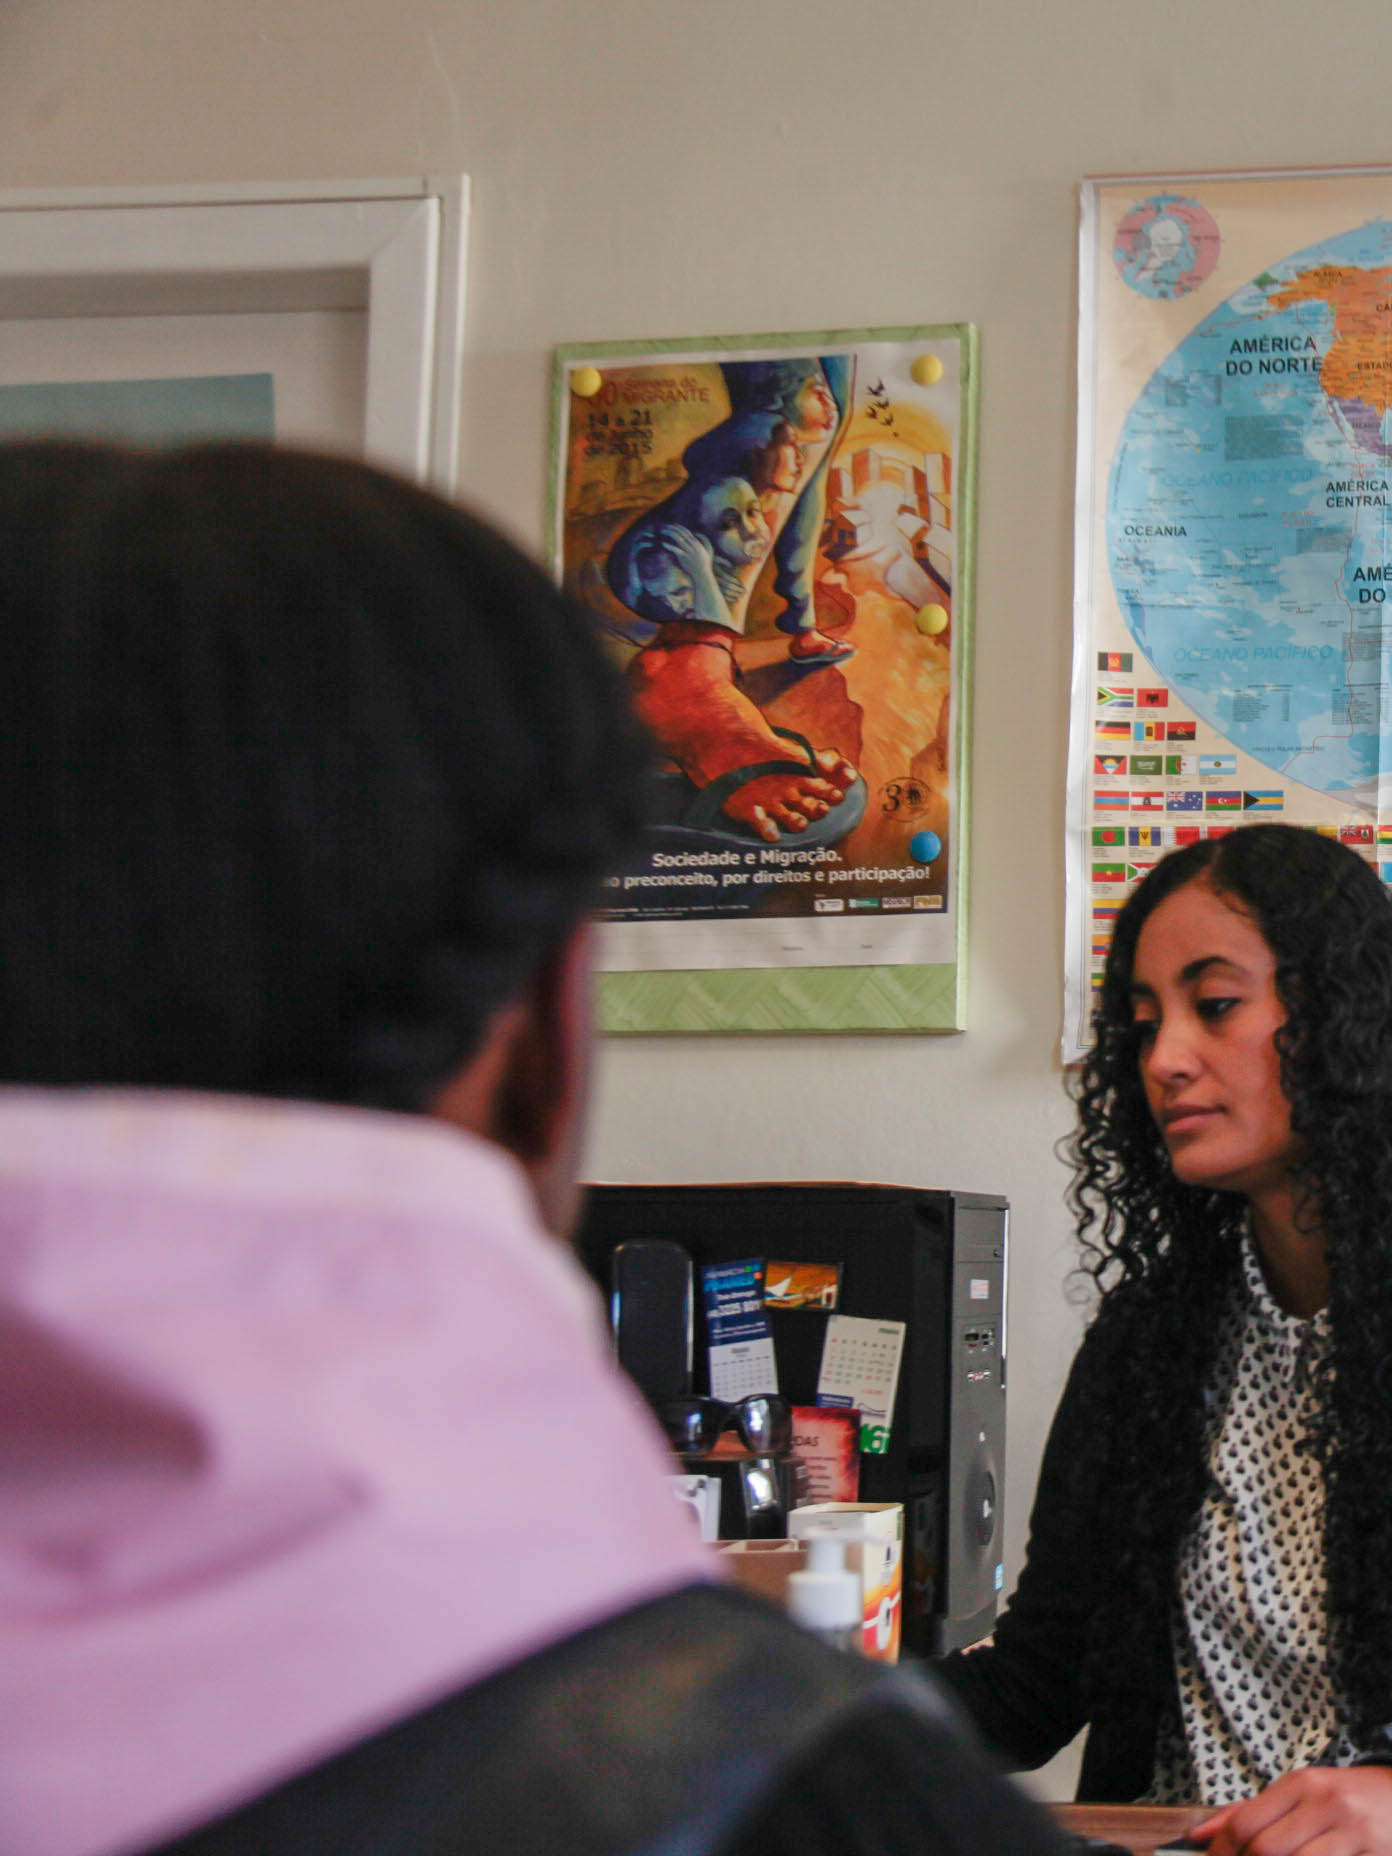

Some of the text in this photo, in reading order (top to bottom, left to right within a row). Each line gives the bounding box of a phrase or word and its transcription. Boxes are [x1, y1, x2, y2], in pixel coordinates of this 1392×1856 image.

[1229, 333, 1318, 354] AMÉRICA
[1226, 356, 1322, 376] DO NORTE
[1325, 477, 1389, 493] AMÉRICA
[1325, 494, 1391, 509] CENTRAL
[1124, 524, 1188, 538] OCEANIA
[1358, 588, 1387, 604] DO
[651, 847, 843, 867] Sociedade e Migração.
[624, 872, 719, 890] preconceito,
[722, 873, 750, 888] por
[753, 869, 811, 884] direitos
[815, 871, 824, 881] e
[828, 866, 931, 884] participação!
